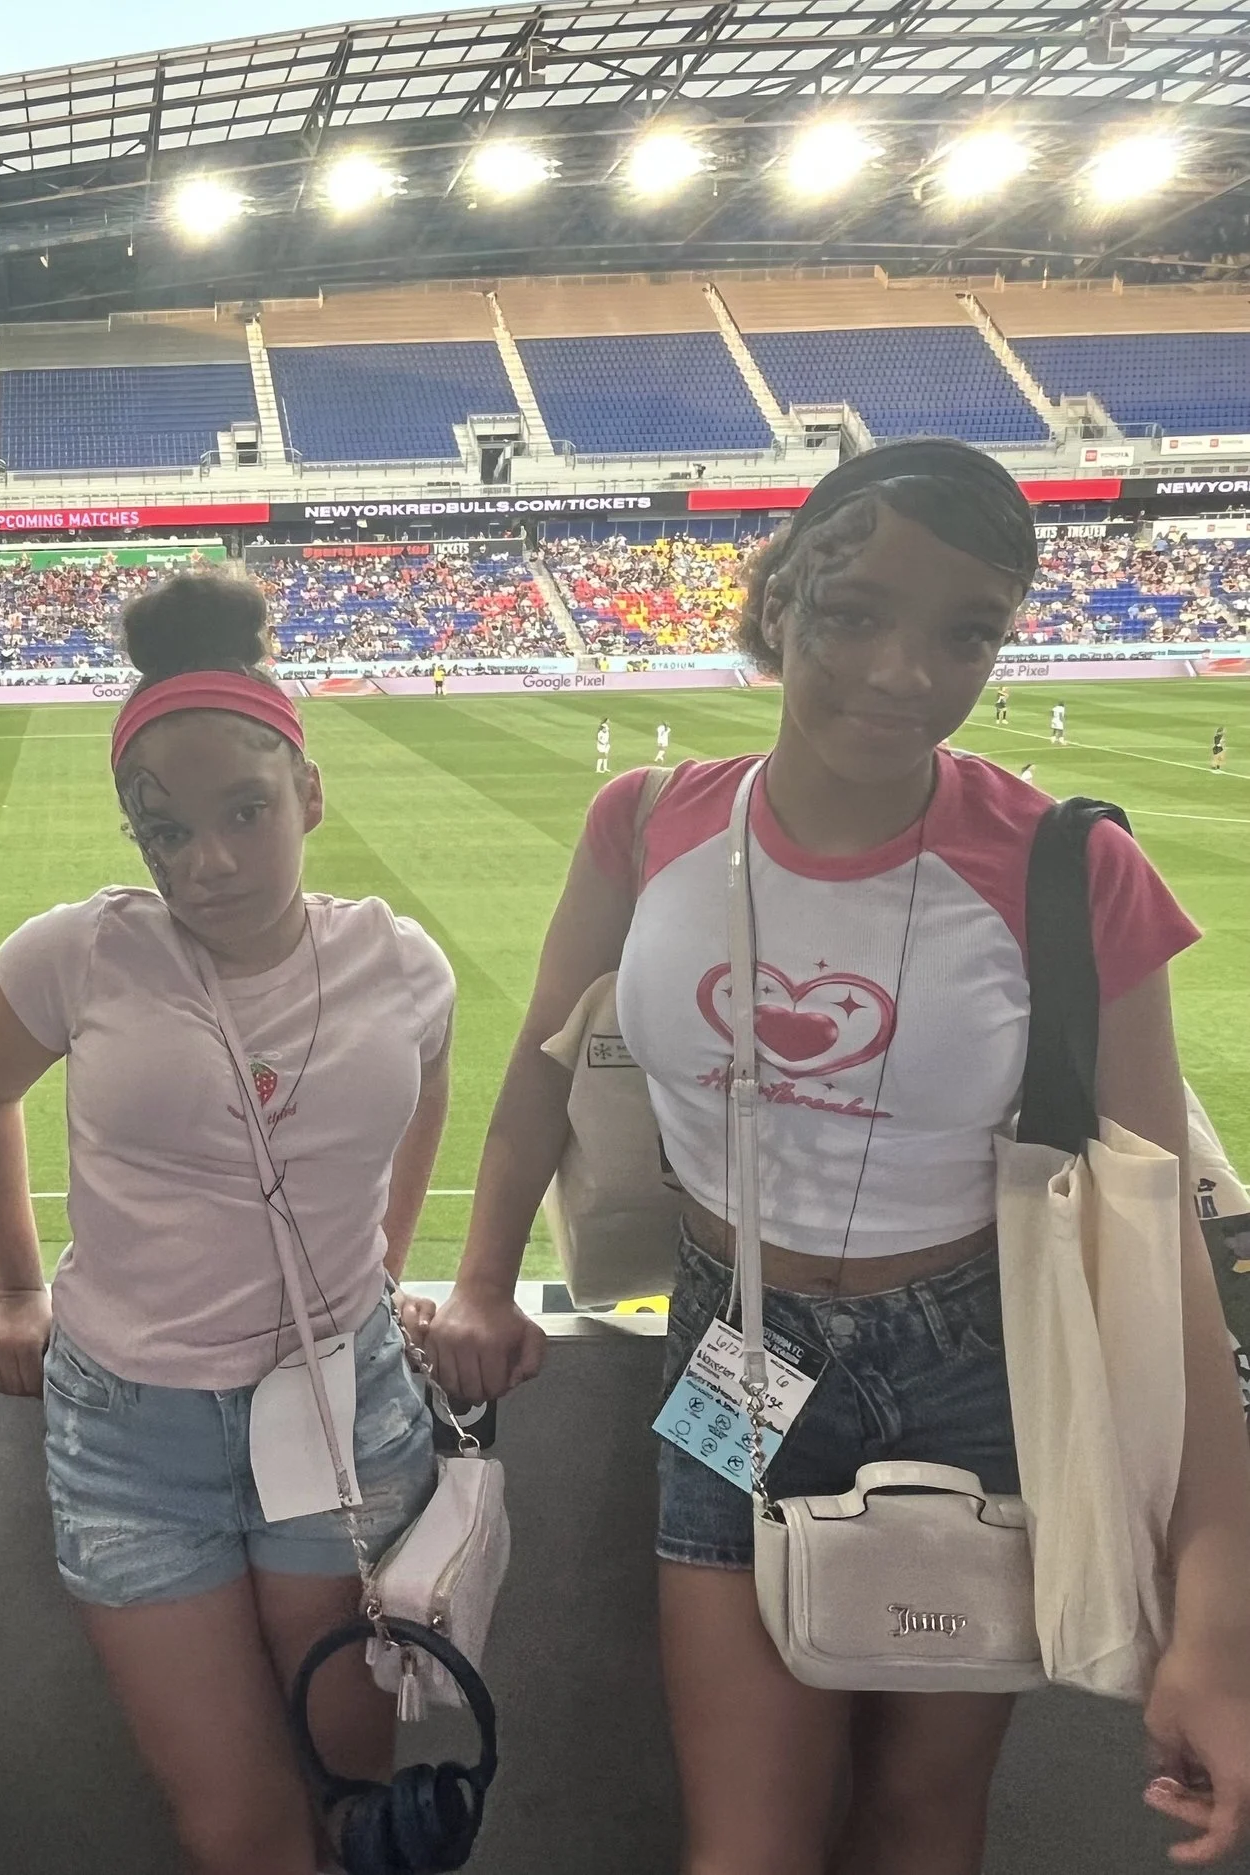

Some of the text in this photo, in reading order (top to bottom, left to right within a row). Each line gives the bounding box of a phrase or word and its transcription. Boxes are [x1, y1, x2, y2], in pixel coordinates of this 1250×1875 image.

[1156, 480, 1250, 495] NEWYOR
[305, 496, 651, 518] NEWYORKREDBULLS.COM/TICKETS
[68, 510, 140, 528] MATCHES
[433, 542, 470, 554] TICKETS
[651, 662, 695, 670] STADIUM
[1017, 664, 1050, 677] Pixel
[523, 673, 606, 691] Google Pixel
[775, 1374, 790, 1389] 6
